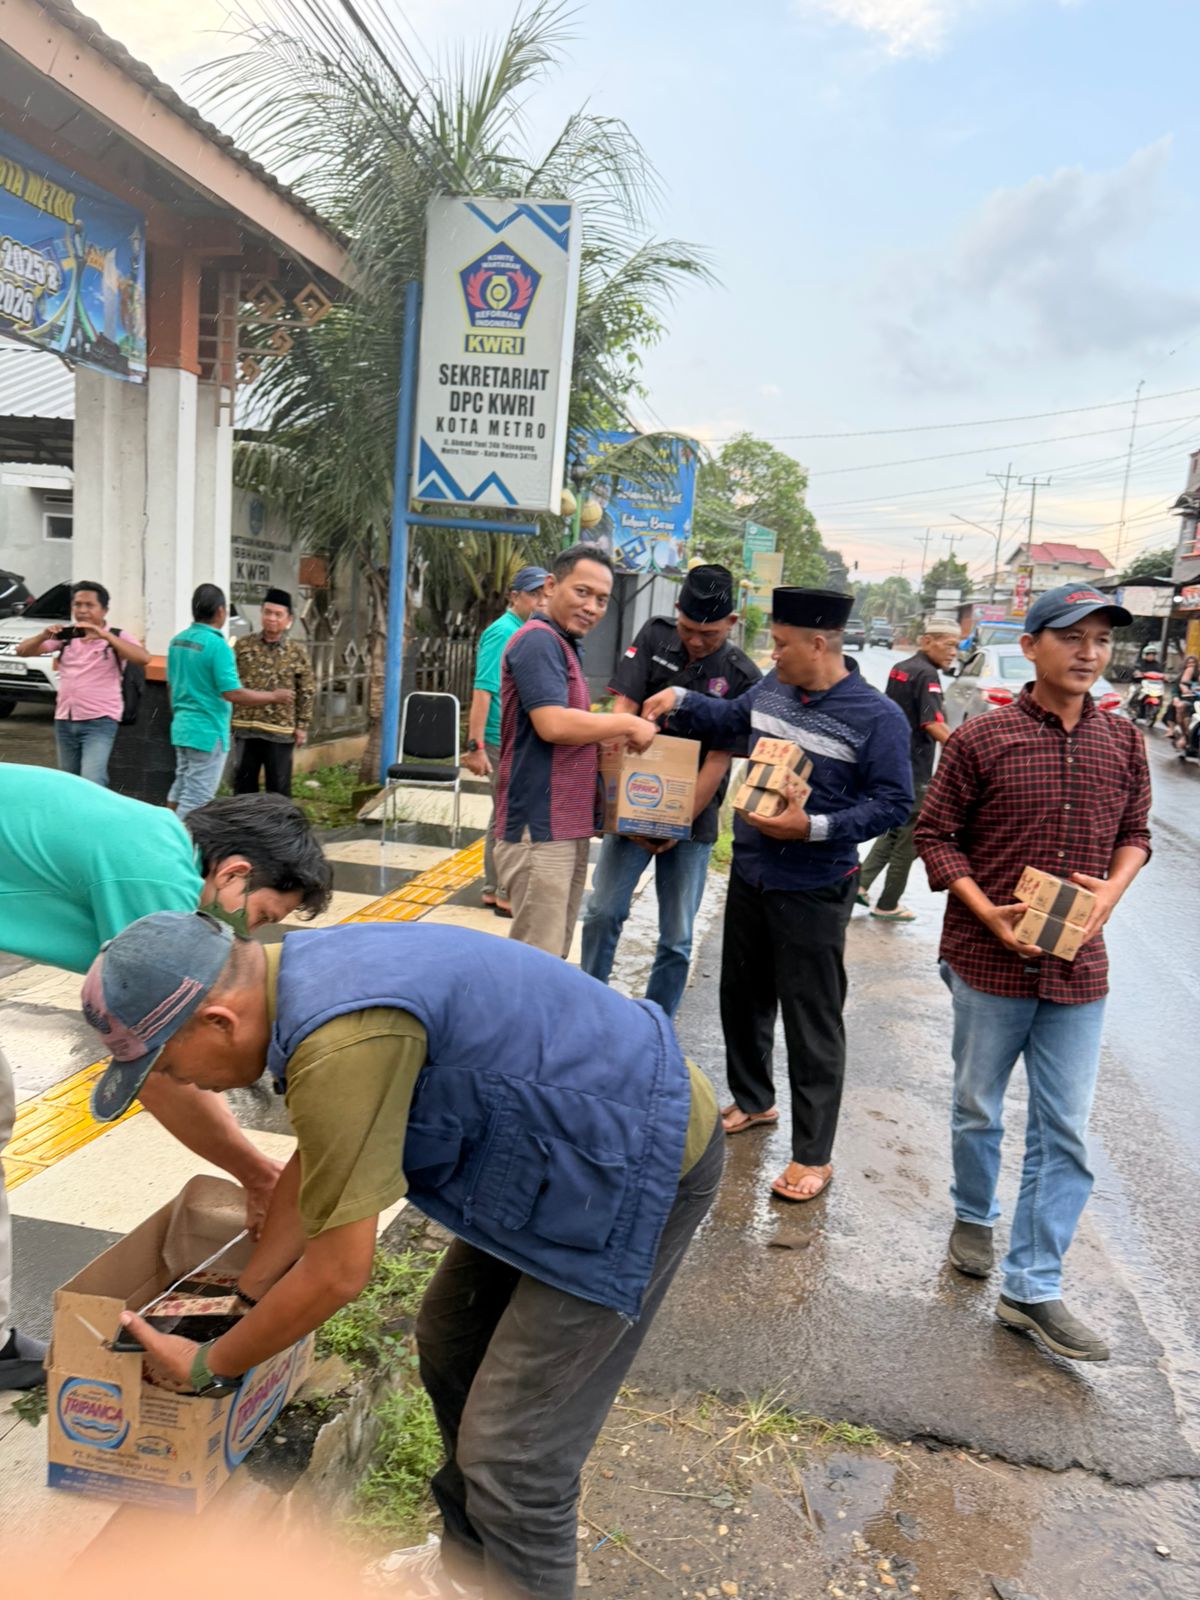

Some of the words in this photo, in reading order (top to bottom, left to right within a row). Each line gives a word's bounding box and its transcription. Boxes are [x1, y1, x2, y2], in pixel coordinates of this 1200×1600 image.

[24, 170, 76, 224] METRO
[2, 239, 46, 286] 2025
[475, 310, 521, 320] REFORMASI
[475, 320, 520, 328] INDONESIA
[468, 335, 521, 353] KWRI
[439, 363, 549, 391] SEKRETARIAT
[450, 391, 483, 413] DPC
[488, 393, 535, 417] KWRI
[436, 417, 478, 435] KOTA
[488, 419, 546, 439] METRO
[441, 447, 459, 455] Metro
[484, 450, 498, 458] Kota
[500, 451, 518, 459] Metro
[236, 562, 270, 581] KWRI
[64, 1396, 123, 1422] TRIPANCA
